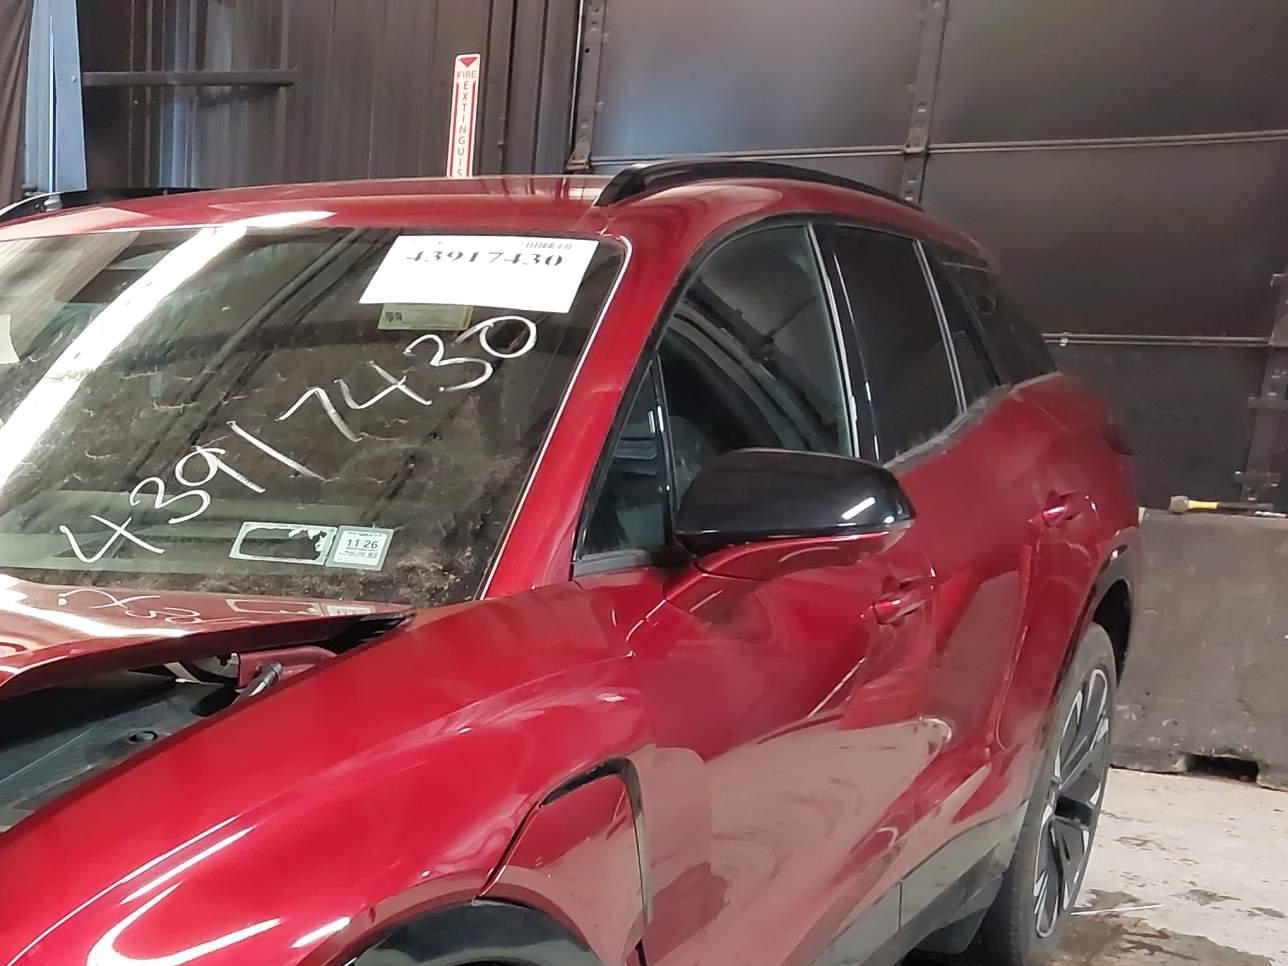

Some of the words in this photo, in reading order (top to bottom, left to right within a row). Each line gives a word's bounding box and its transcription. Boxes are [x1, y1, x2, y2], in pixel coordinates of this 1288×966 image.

[456, 70, 478, 79] FIRE
[406, 250, 563, 267] 43917430
[59, 314, 538, 564] 43917430
